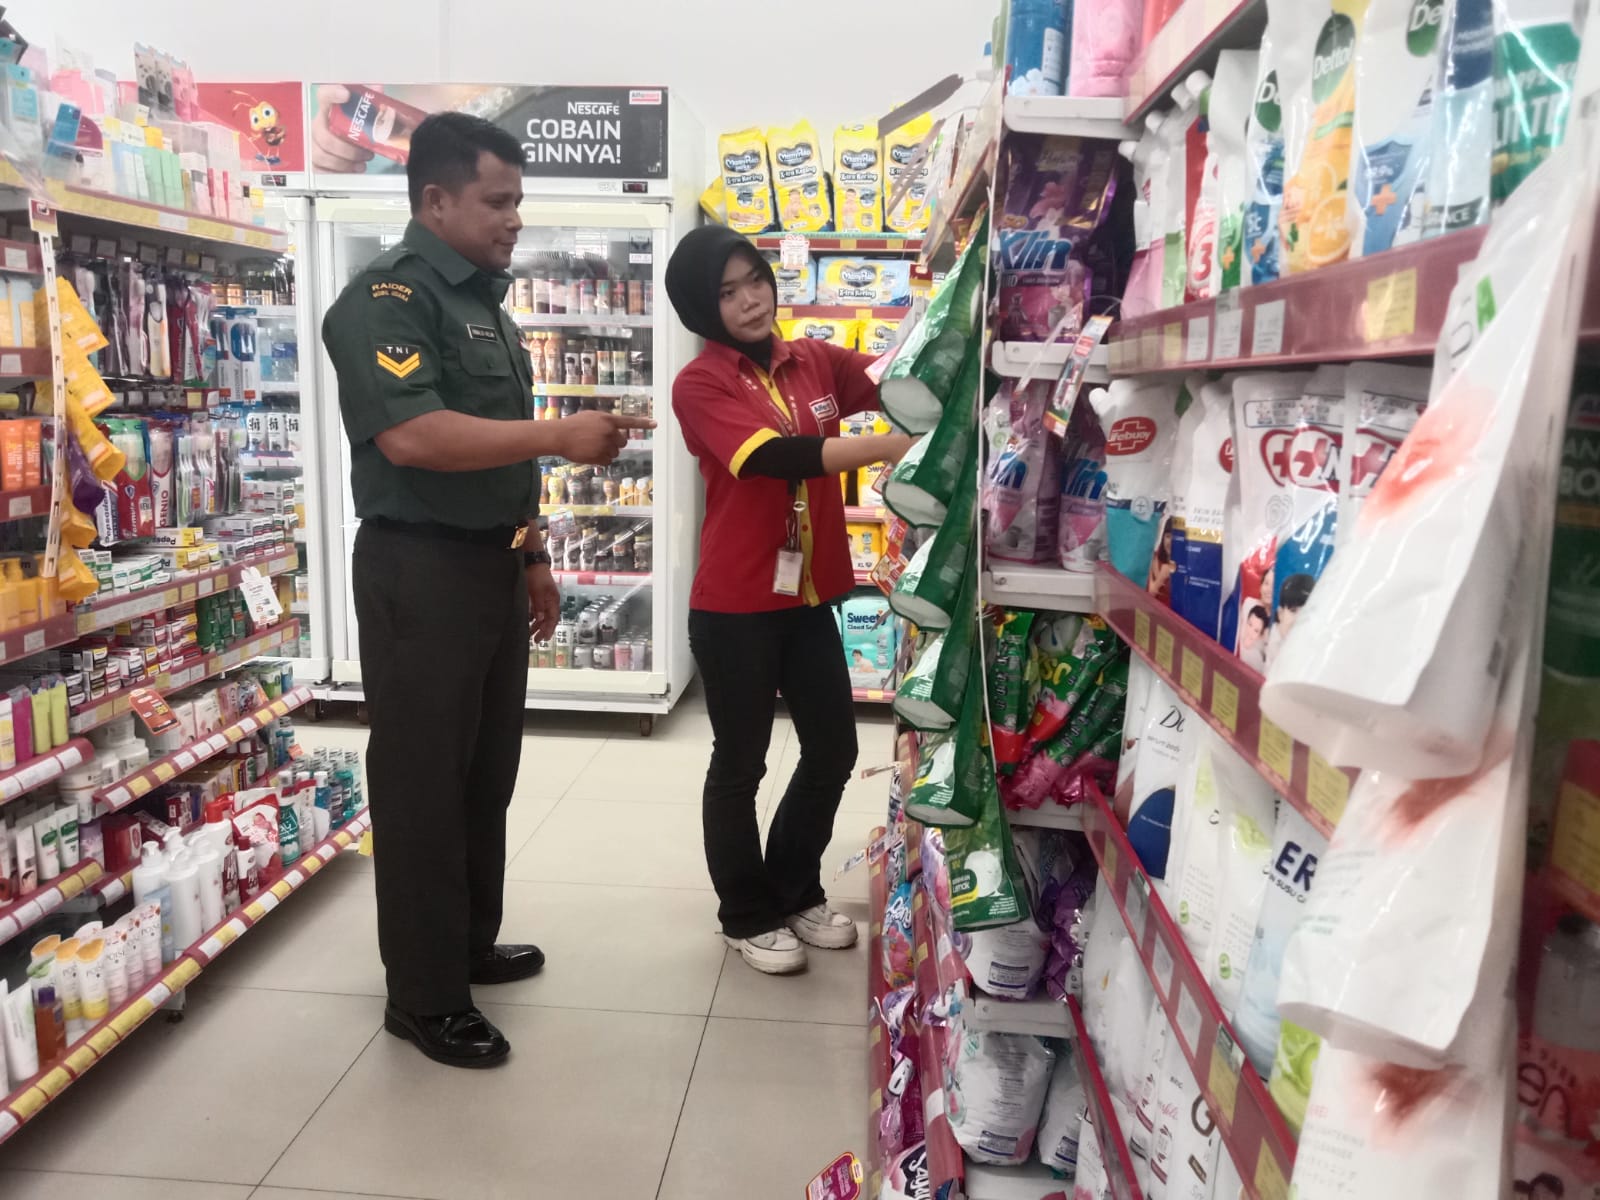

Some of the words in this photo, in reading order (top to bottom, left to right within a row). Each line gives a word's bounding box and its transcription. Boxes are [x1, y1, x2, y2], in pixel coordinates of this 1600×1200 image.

[1313, 39, 1355, 79] Dettol
[526, 118, 621, 140] COBAIN
[370, 282, 414, 296] RAIDER
